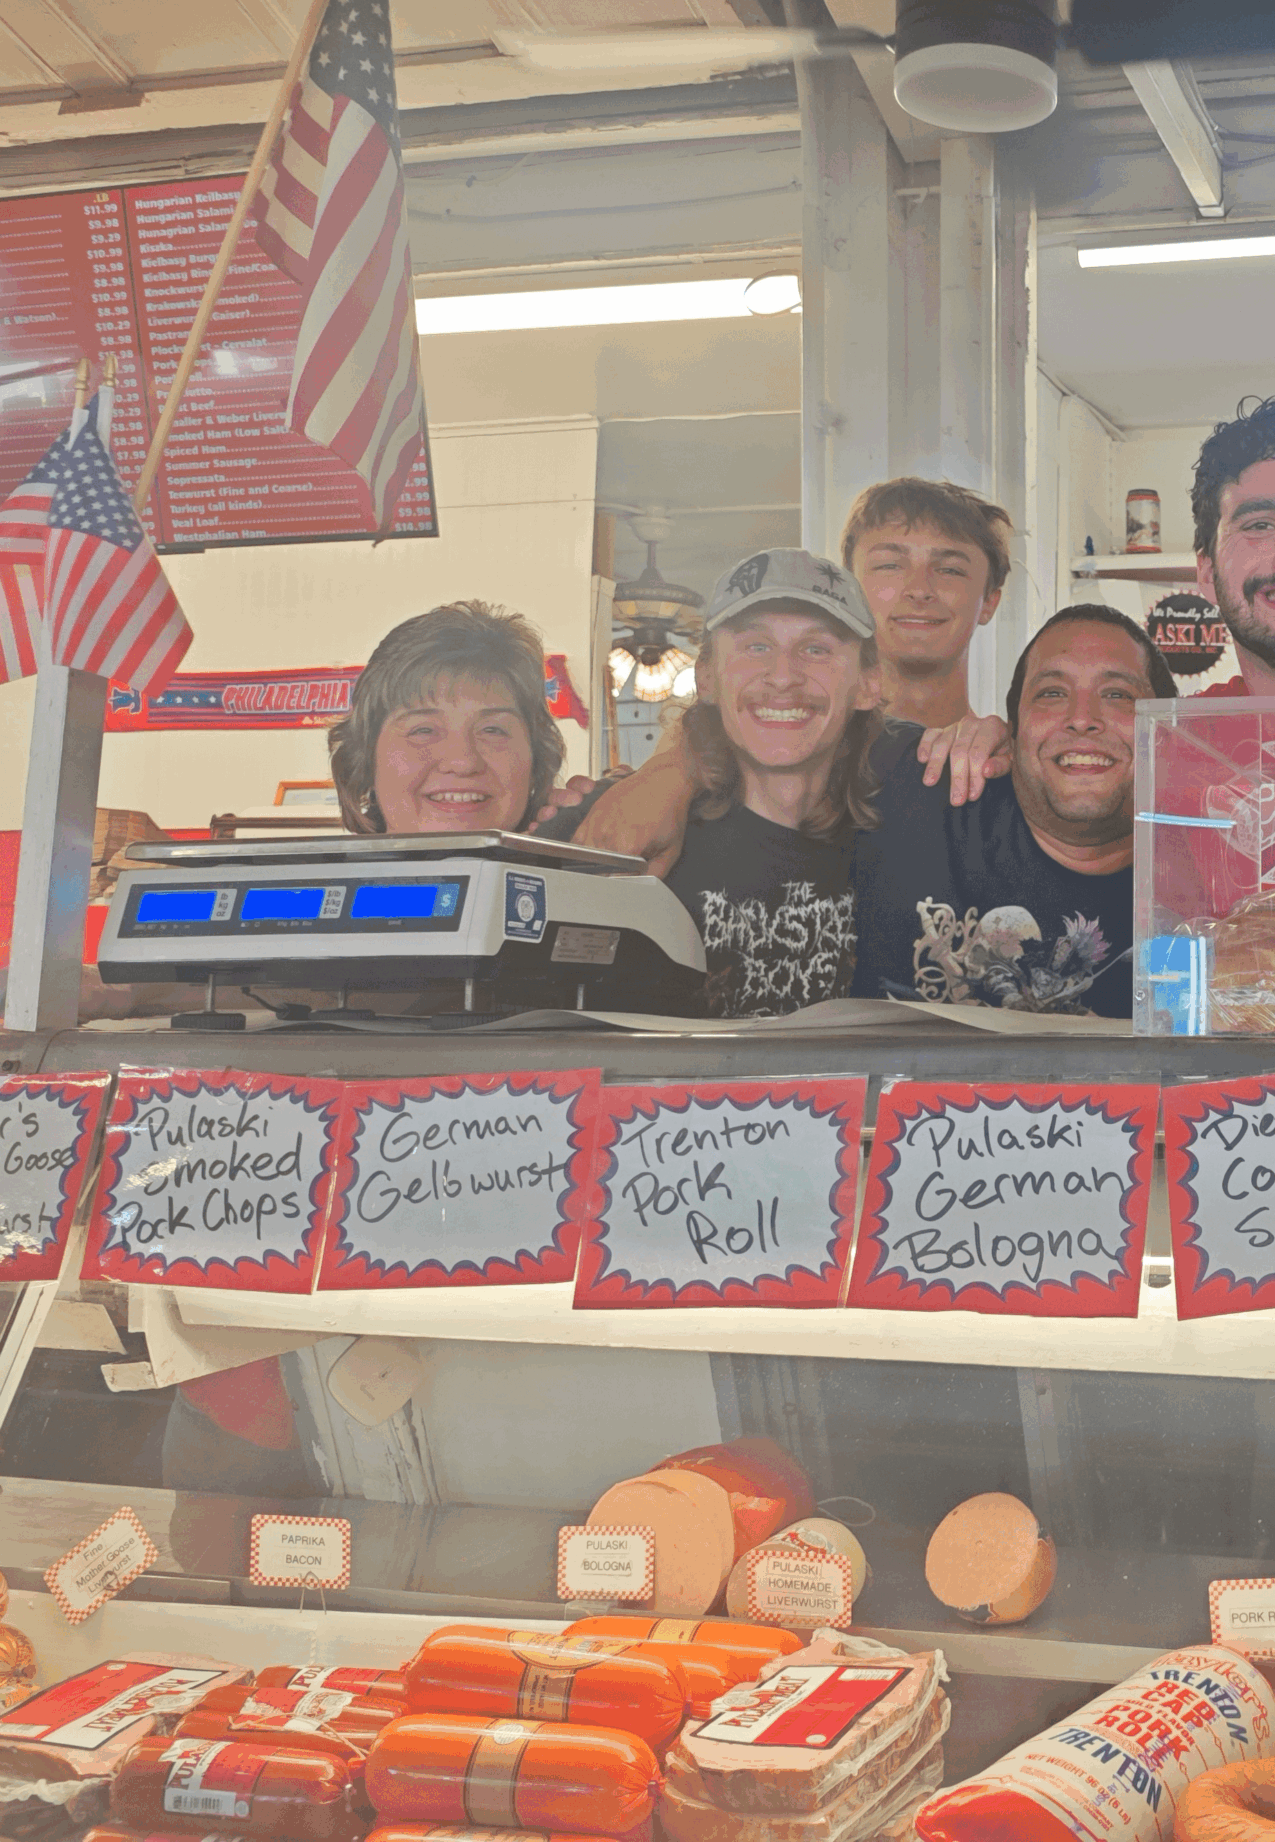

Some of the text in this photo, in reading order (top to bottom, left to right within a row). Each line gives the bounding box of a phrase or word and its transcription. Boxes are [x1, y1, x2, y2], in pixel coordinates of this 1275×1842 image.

[83, 203, 118, 215] $11.99
[135, 195, 192, 209] Hungarian
[137, 205, 234, 224] Hungarian Salami
[88, 218, 119, 229] $9.98
[91, 233, 121, 244] $9.29
[87, 248, 123, 259] $10.99
[93, 262, 124, 273] $9.98
[141, 255, 187, 268] Kielbasy
[94, 277, 125, 288] $8.98
[143, 269, 188, 283] Kielbasy
[92, 291, 127, 303] $10.99
[98, 306, 129, 317] $8.98
[100, 335, 132, 346] $8.98
[217, 414, 250, 425] Weber
[206, 430, 232, 439] Ham
[163, 445, 227, 458] Spiced Ham
[165, 458, 258, 471] Summer Sausage
[167, 474, 225, 486] Sopressata
[168, 482, 313, 499] Teewurst (Fine and Coarse)
[170, 500, 263, 515] Turkey (all kinds)
[172, 516, 219, 528] Veal Loaf
[173, 529, 267, 543] Westphalian Ham
[222, 680, 350, 714] PHILADELPHIA
[133, 1103, 272, 1151] Pulaski
[379, 1111, 544, 1163] German
[620, 1117, 790, 1168] Trenton
[907, 1115, 1084, 1167] Pulaski
[3, 1141, 74, 1175] Goose
[622, 1161, 732, 1226] Pork
[916, 1166, 1127, 1220] German
[202, 1187, 301, 1240] Chops
[686, 1197, 780, 1264] Roll
[893, 1224, 1122, 1281] Bologna
[281, 1534, 326, 1547] PAPRIKA
[586, 1540, 628, 1551] PULASKI
[82, 1543, 104, 1562] Fine
[285, 1554, 322, 1566] BACON
[75, 1536, 135, 1591] Mother Goose
[583, 1560, 631, 1572] BOLOGNA
[772, 1561, 818, 1576] PULASKI
[768, 1578, 831, 1593] HOMEMADE
[767, 1595, 839, 1610] LIVERWURST
[1231, 1611, 1265, 1624] PORK
[1149, 1670, 1249, 1745] TRENTON
[1155, 1680, 1217, 1722] RED
[1140, 1690, 1206, 1729] CAP
[1105, 1704, 1190, 1762] PORK
[1156, 1710, 1196, 1747] FLAVOR
[1094, 1715, 1164, 1772] ROLL
[1046, 1755, 1099, 1789] WEIGHT 96
[1048, 1727, 1163, 1815] TRENTON
